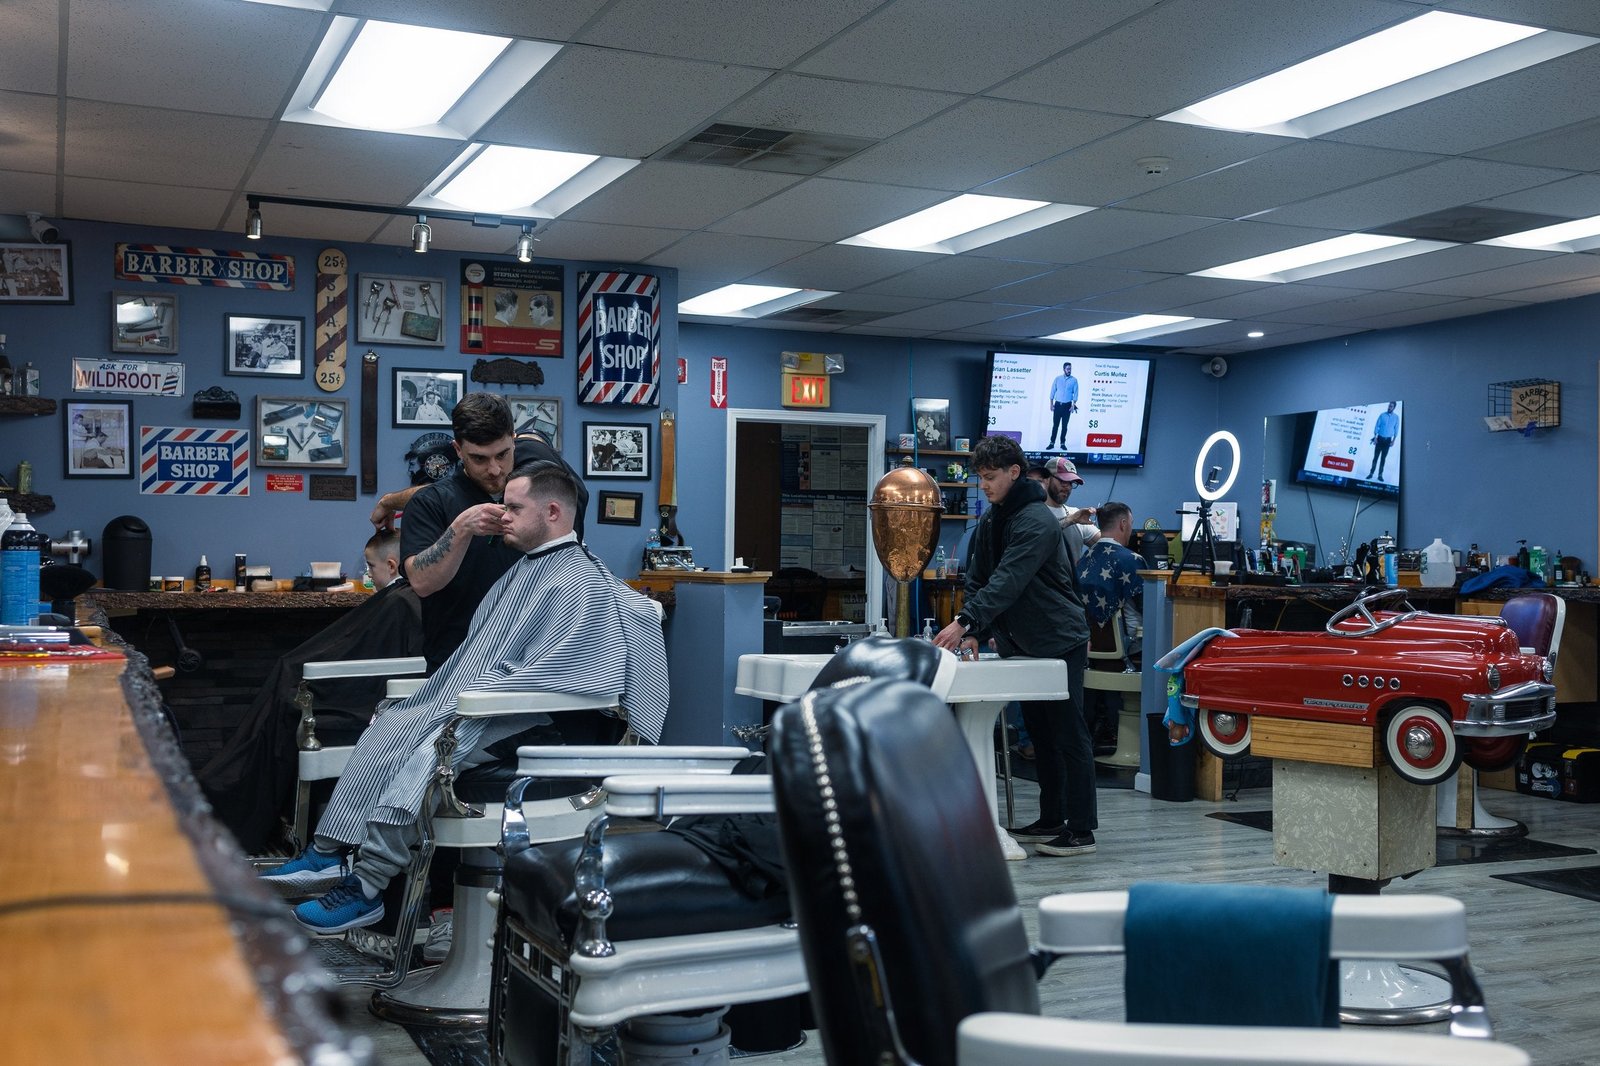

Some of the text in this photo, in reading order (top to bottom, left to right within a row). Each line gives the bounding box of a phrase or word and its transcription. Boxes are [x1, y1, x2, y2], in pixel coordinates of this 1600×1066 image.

[127, 253, 285, 281] BARBER SHOP
[324, 256, 345, 268] 25¢
[326, 279, 337, 362] SHAVE
[595, 306, 652, 341] BARBER
[602, 344, 647, 370] SHOP
[99, 363, 139, 371] ASK FOR
[713, 362, 725, 370] FIRE
[77, 370, 162, 390] WILDROOT
[320, 372, 341, 385] 25¢
[792, 377, 826, 404] EXIT
[1519, 388, 1550, 402] BARBER
[1088, 419, 1099, 429] $8
[160, 445, 231, 461] BARBER
[170, 463, 221, 479] SHOP
